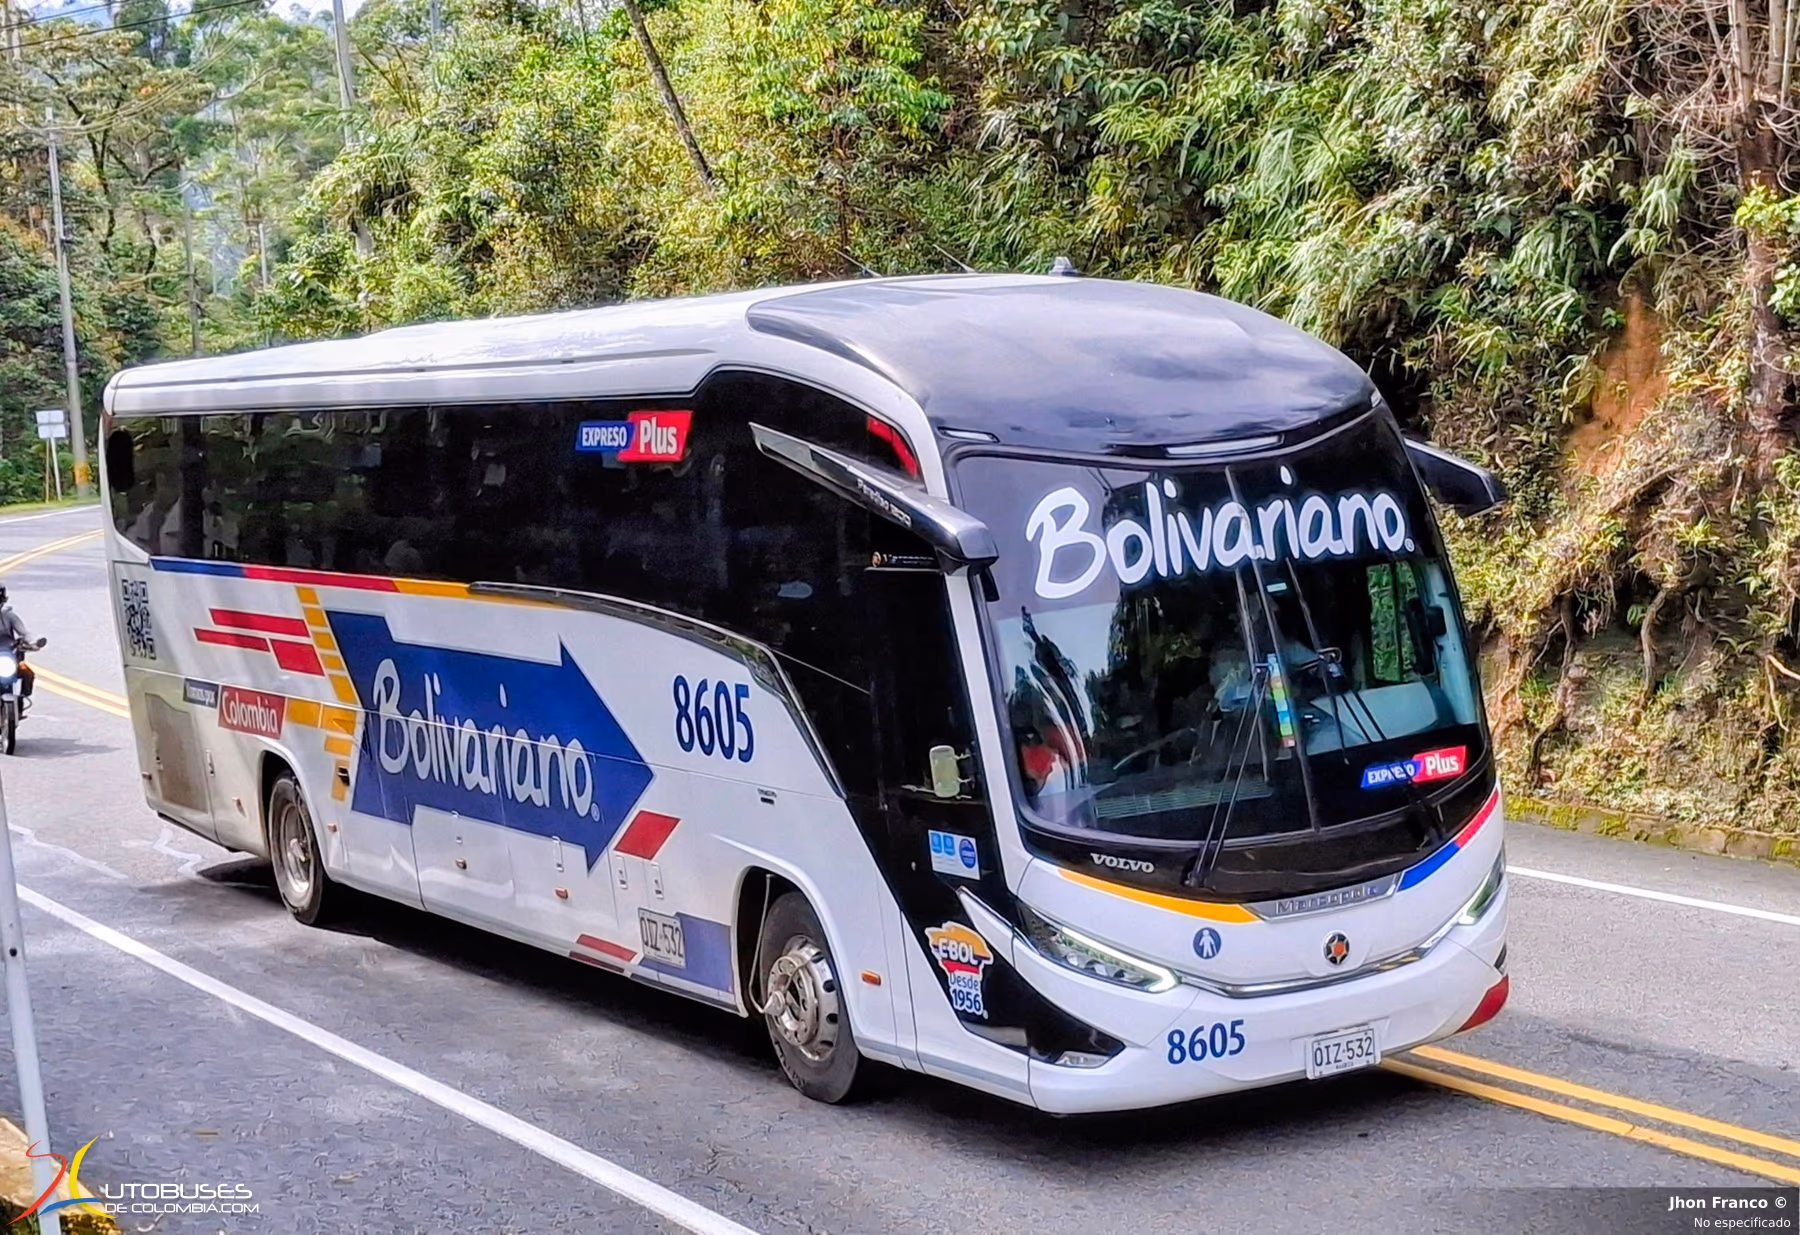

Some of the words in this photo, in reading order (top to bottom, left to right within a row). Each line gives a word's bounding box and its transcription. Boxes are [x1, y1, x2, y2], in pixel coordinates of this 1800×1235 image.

[582, 426, 628, 447] EXPRESO
[640, 416, 678, 455] Plus
[1026, 464, 1406, 600] Bolivariano
[222, 691, 279, 734] Colombia
[673, 675, 754, 763] 8605
[373, 658, 592, 818] Bolivariano
[1424, 753, 1459, 776] Plus
[1091, 853, 1154, 873] VOLVO
[950, 972, 978, 990] Desde
[952, 989, 981, 1012] 1956
[1167, 1019, 1245, 1065] 8605
